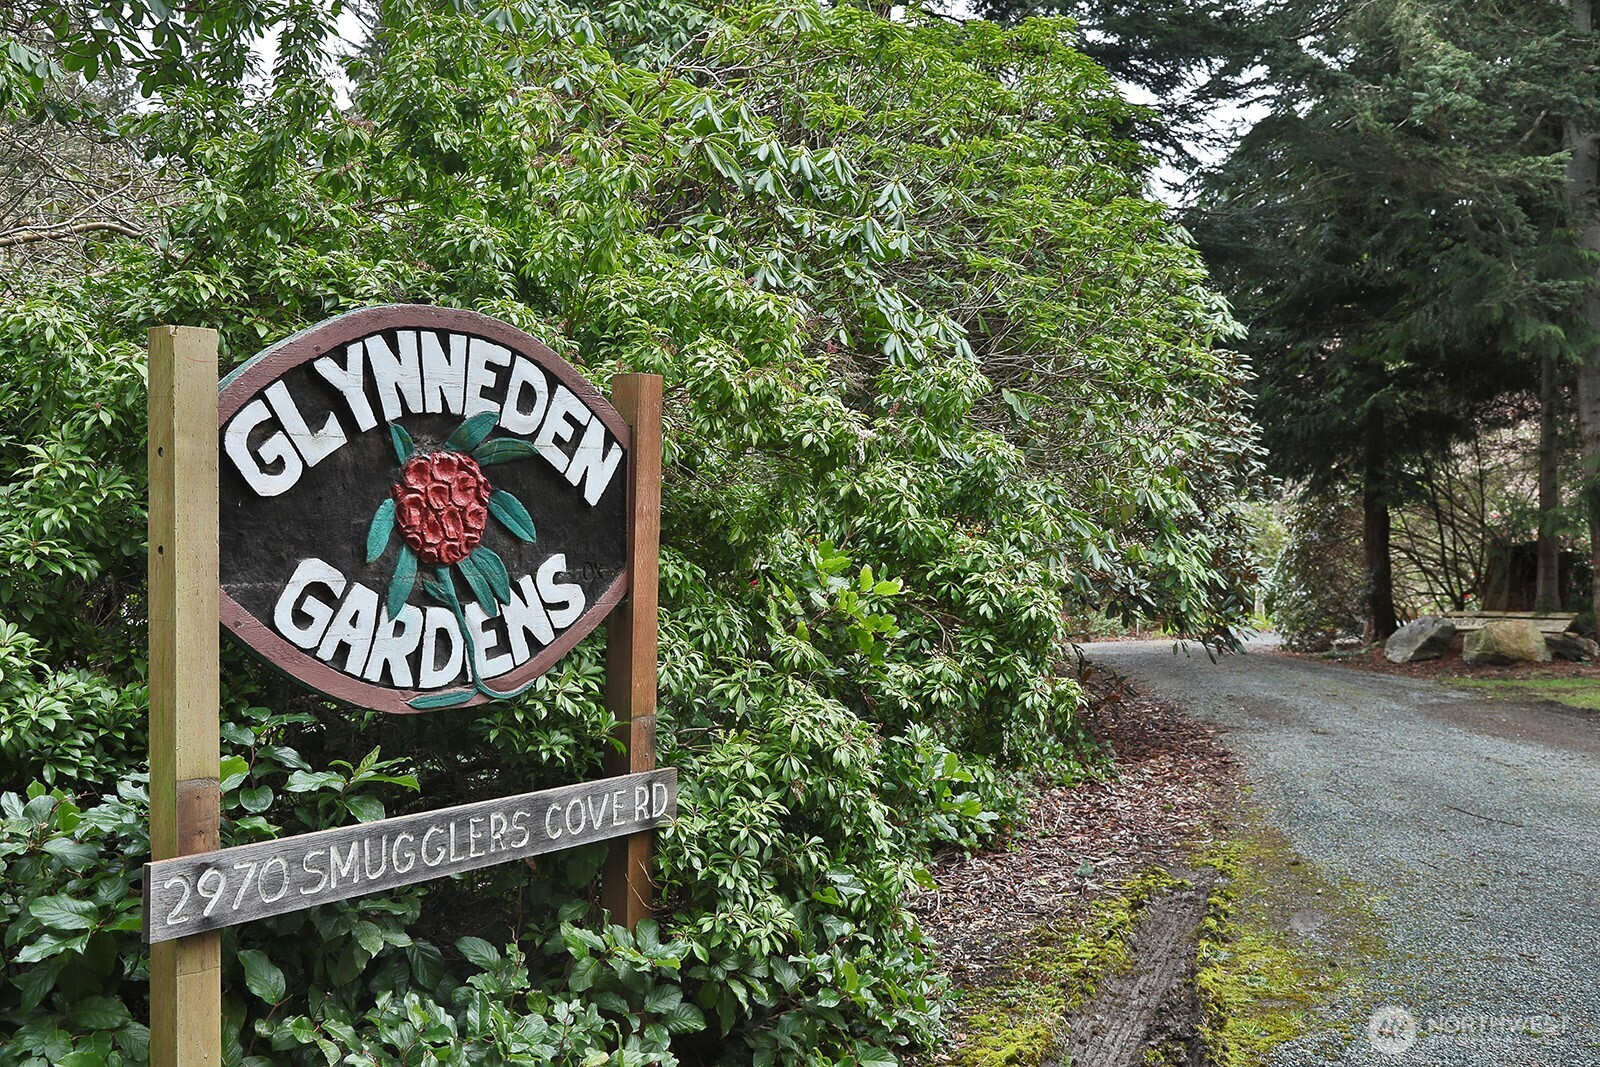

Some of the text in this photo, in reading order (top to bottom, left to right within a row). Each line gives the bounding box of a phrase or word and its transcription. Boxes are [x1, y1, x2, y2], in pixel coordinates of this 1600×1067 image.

[223, 330, 623, 506] GLYNNEDEN
[273, 553, 586, 689] GARDENS
[164, 784, 669, 926] 2970 SMUGGLERS COVE RD
